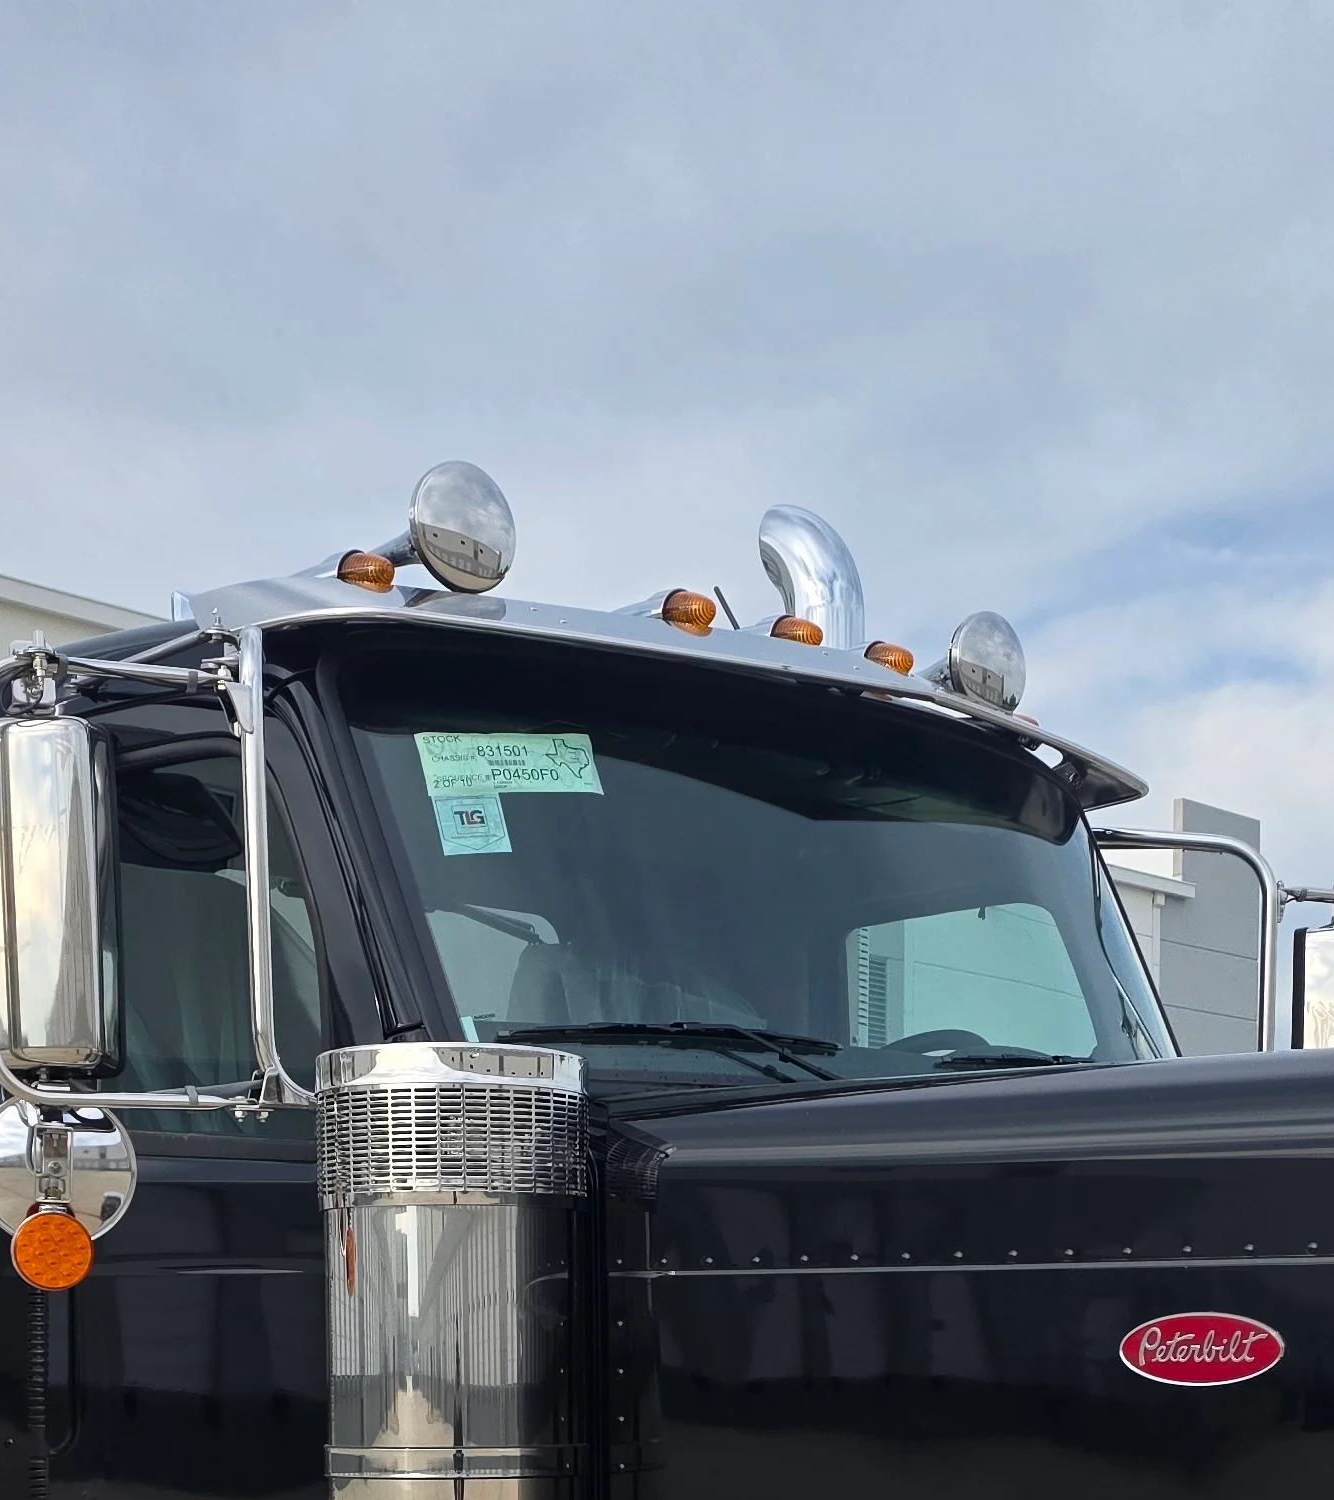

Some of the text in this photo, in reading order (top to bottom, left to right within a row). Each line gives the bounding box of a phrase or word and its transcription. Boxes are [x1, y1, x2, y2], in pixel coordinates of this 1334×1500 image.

[423, 735, 462, 744] STOCK
[477, 744, 529, 757] 831501
[491, 768, 559, 781] P0450F0
[433, 777, 473, 788] 2 OF 10
[453, 810, 486, 826] TLG
[1139, 1326, 1269, 1367] Peterbilt
